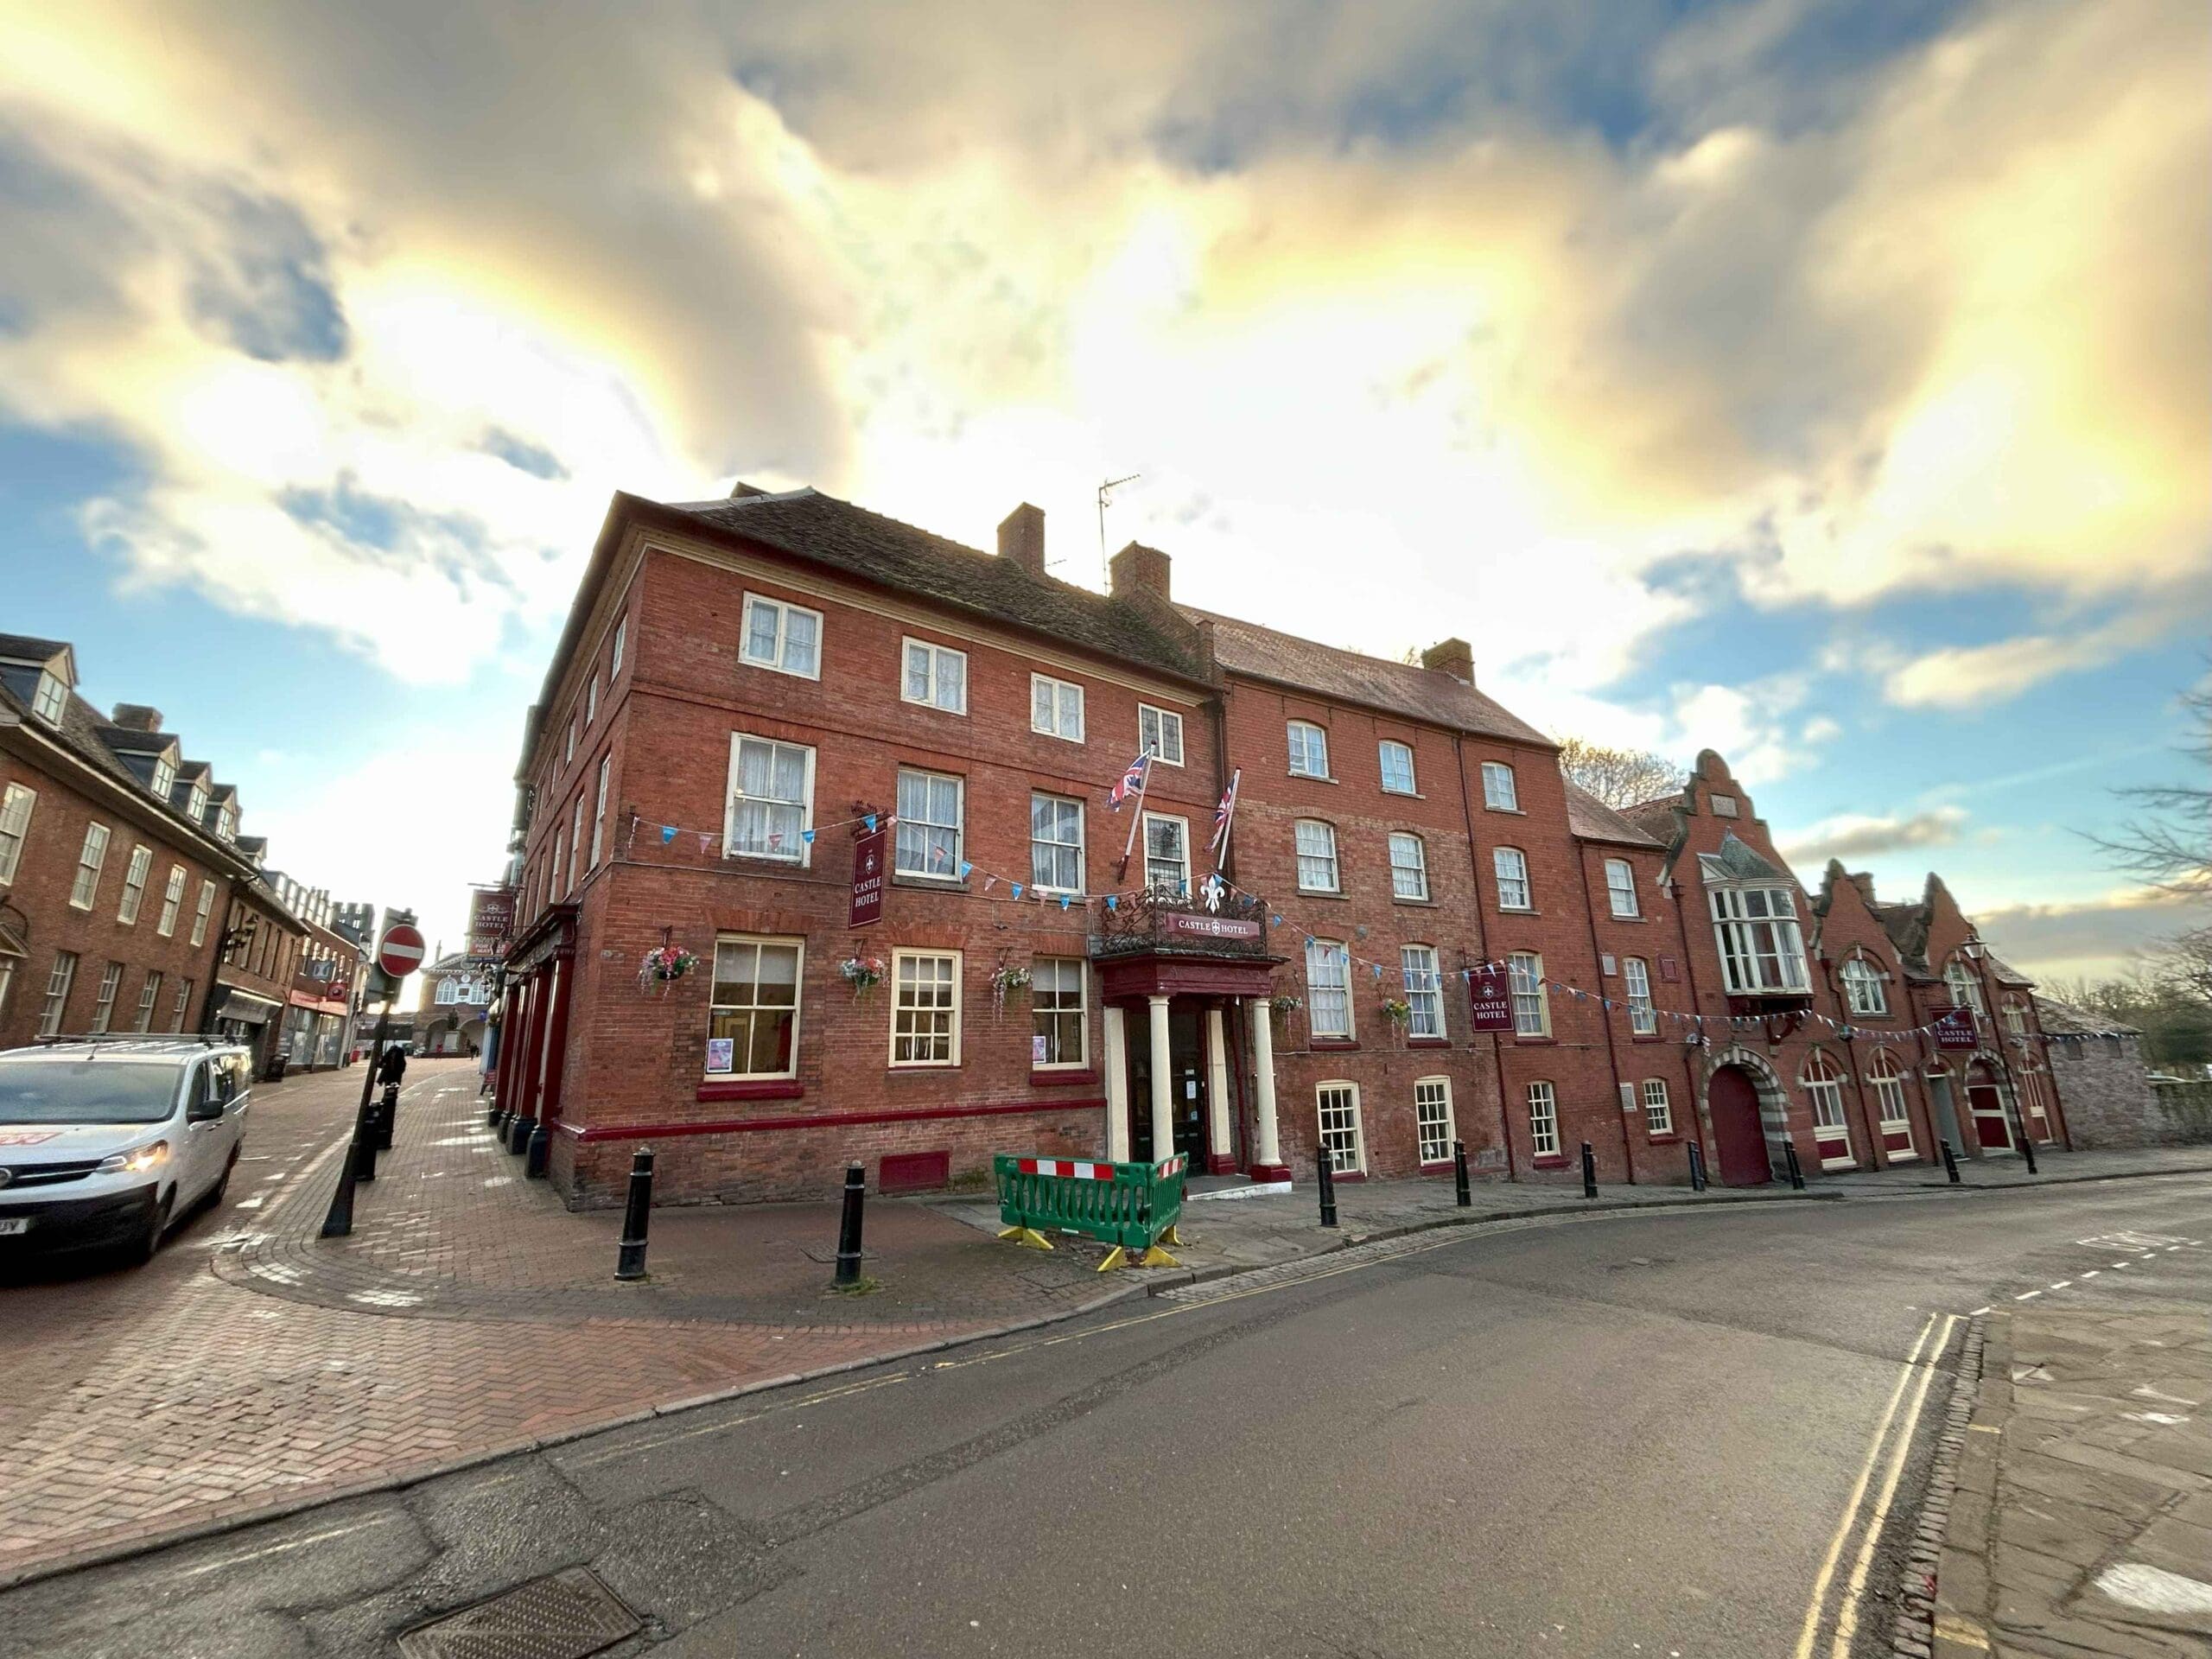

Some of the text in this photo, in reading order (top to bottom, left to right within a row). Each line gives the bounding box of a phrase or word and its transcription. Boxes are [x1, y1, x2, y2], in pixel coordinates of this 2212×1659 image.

[855, 876, 881, 893] CASTLE
[855, 892, 879, 907] HOTEL
[1178, 919, 1249, 935] CASTLE HOTEL
[1473, 1001, 1508, 1011] CASTLE
[1477, 1010, 1508, 1020] HOTEL
